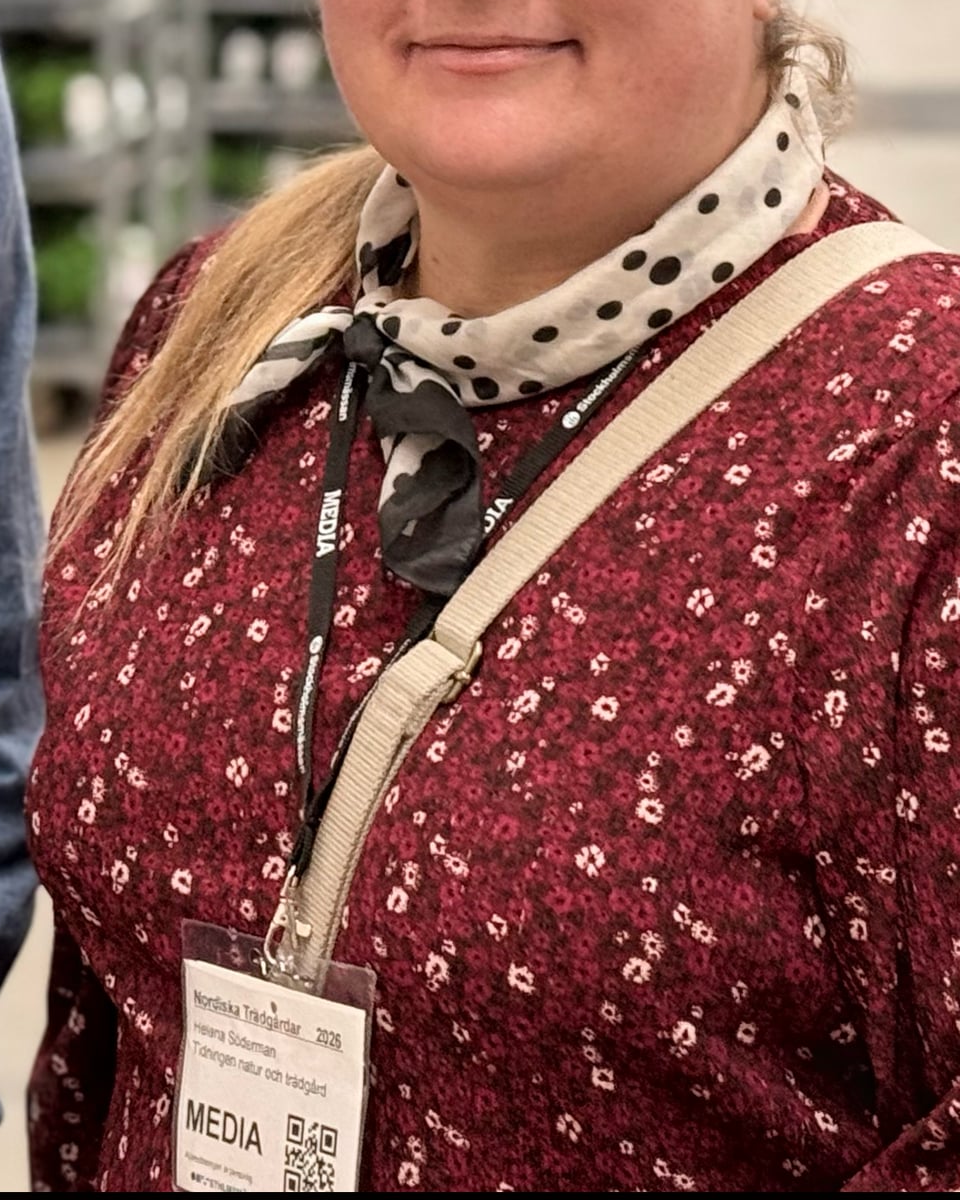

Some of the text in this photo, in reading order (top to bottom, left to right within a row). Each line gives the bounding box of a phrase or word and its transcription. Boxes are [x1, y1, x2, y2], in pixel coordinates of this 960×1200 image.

[316, 488, 342, 558] MEDIA
[484, 497, 514, 534] DIA
[193, 989, 343, 1049] Nordiska Trädgårdar 2026
[238, 1058, 263, 1076] natur
[265, 1066, 284, 1082] och
[185, 1098, 263, 1156] MEDIA
